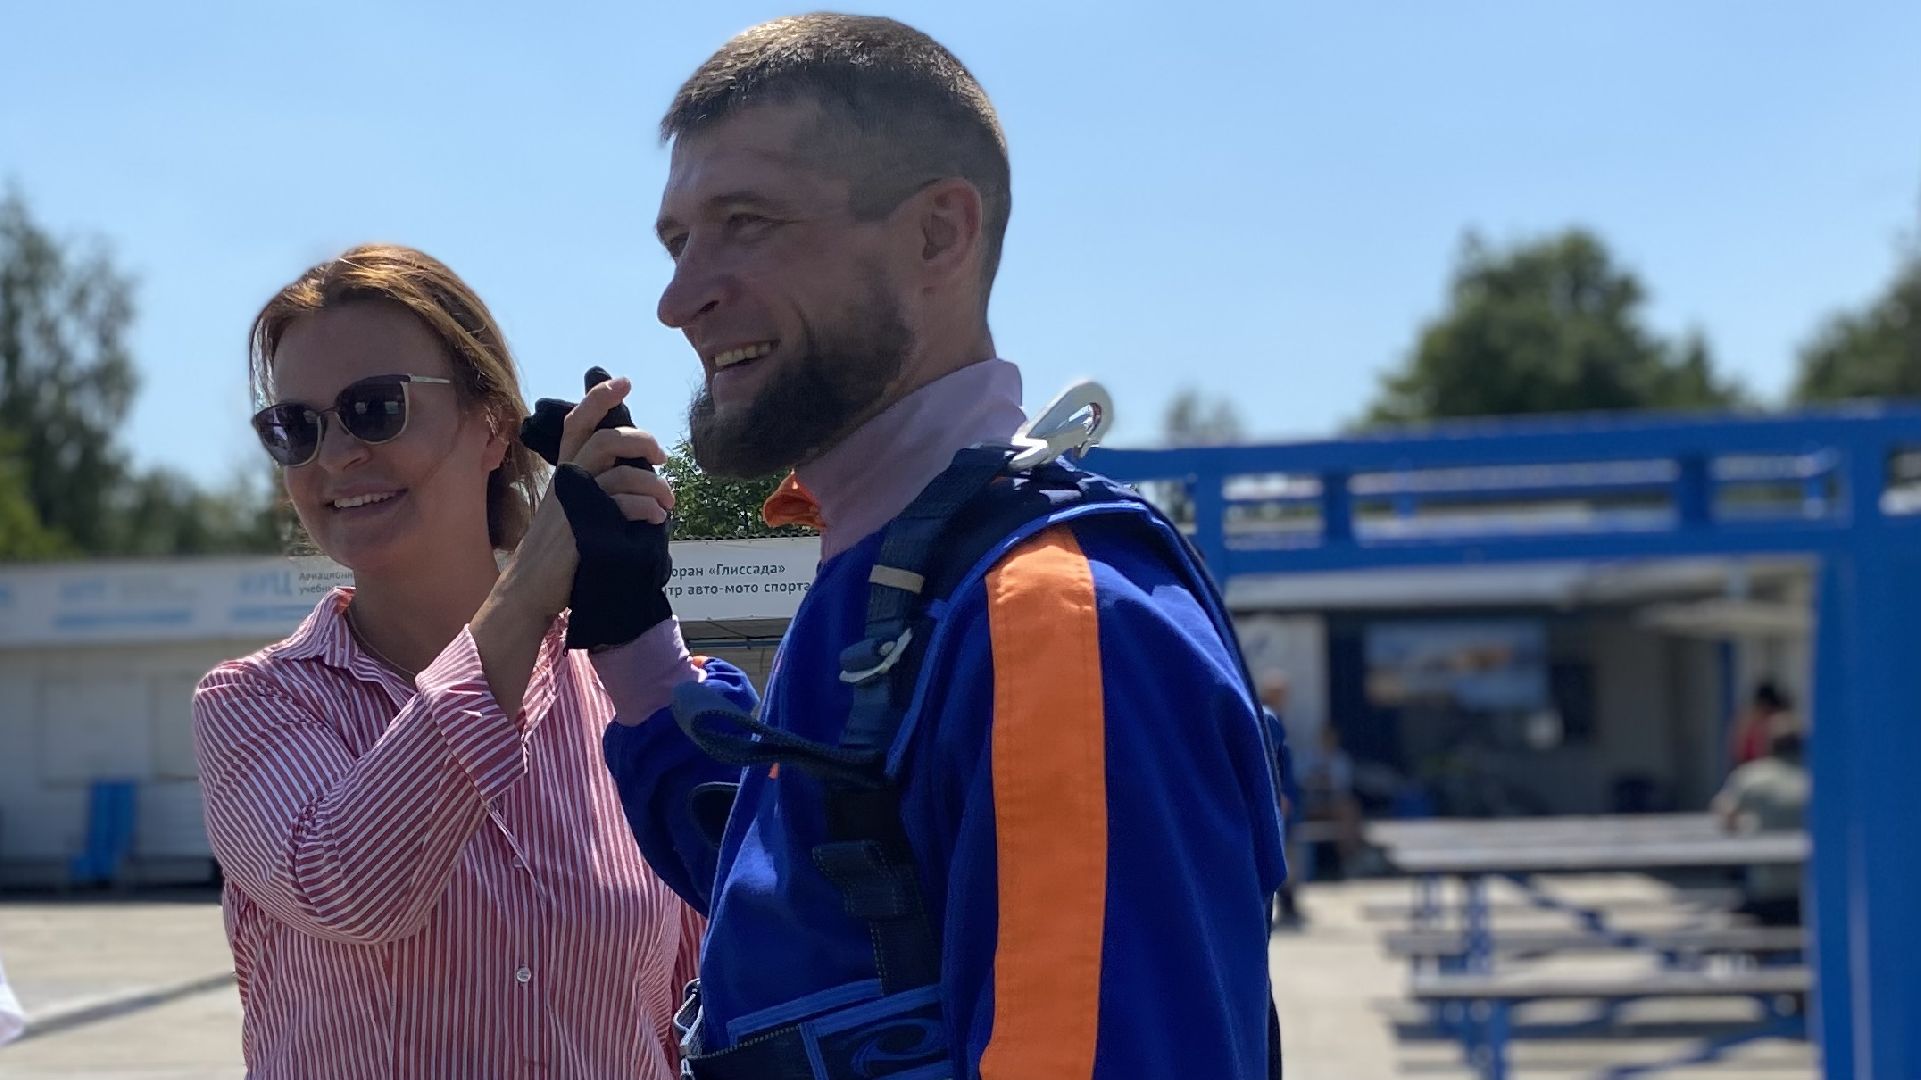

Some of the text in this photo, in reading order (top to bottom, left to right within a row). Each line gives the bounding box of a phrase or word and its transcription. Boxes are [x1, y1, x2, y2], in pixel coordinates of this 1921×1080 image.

[672, 563, 786, 580] оран «Глиссада»
[665, 582, 811, 599] тр авто-мото спорта
